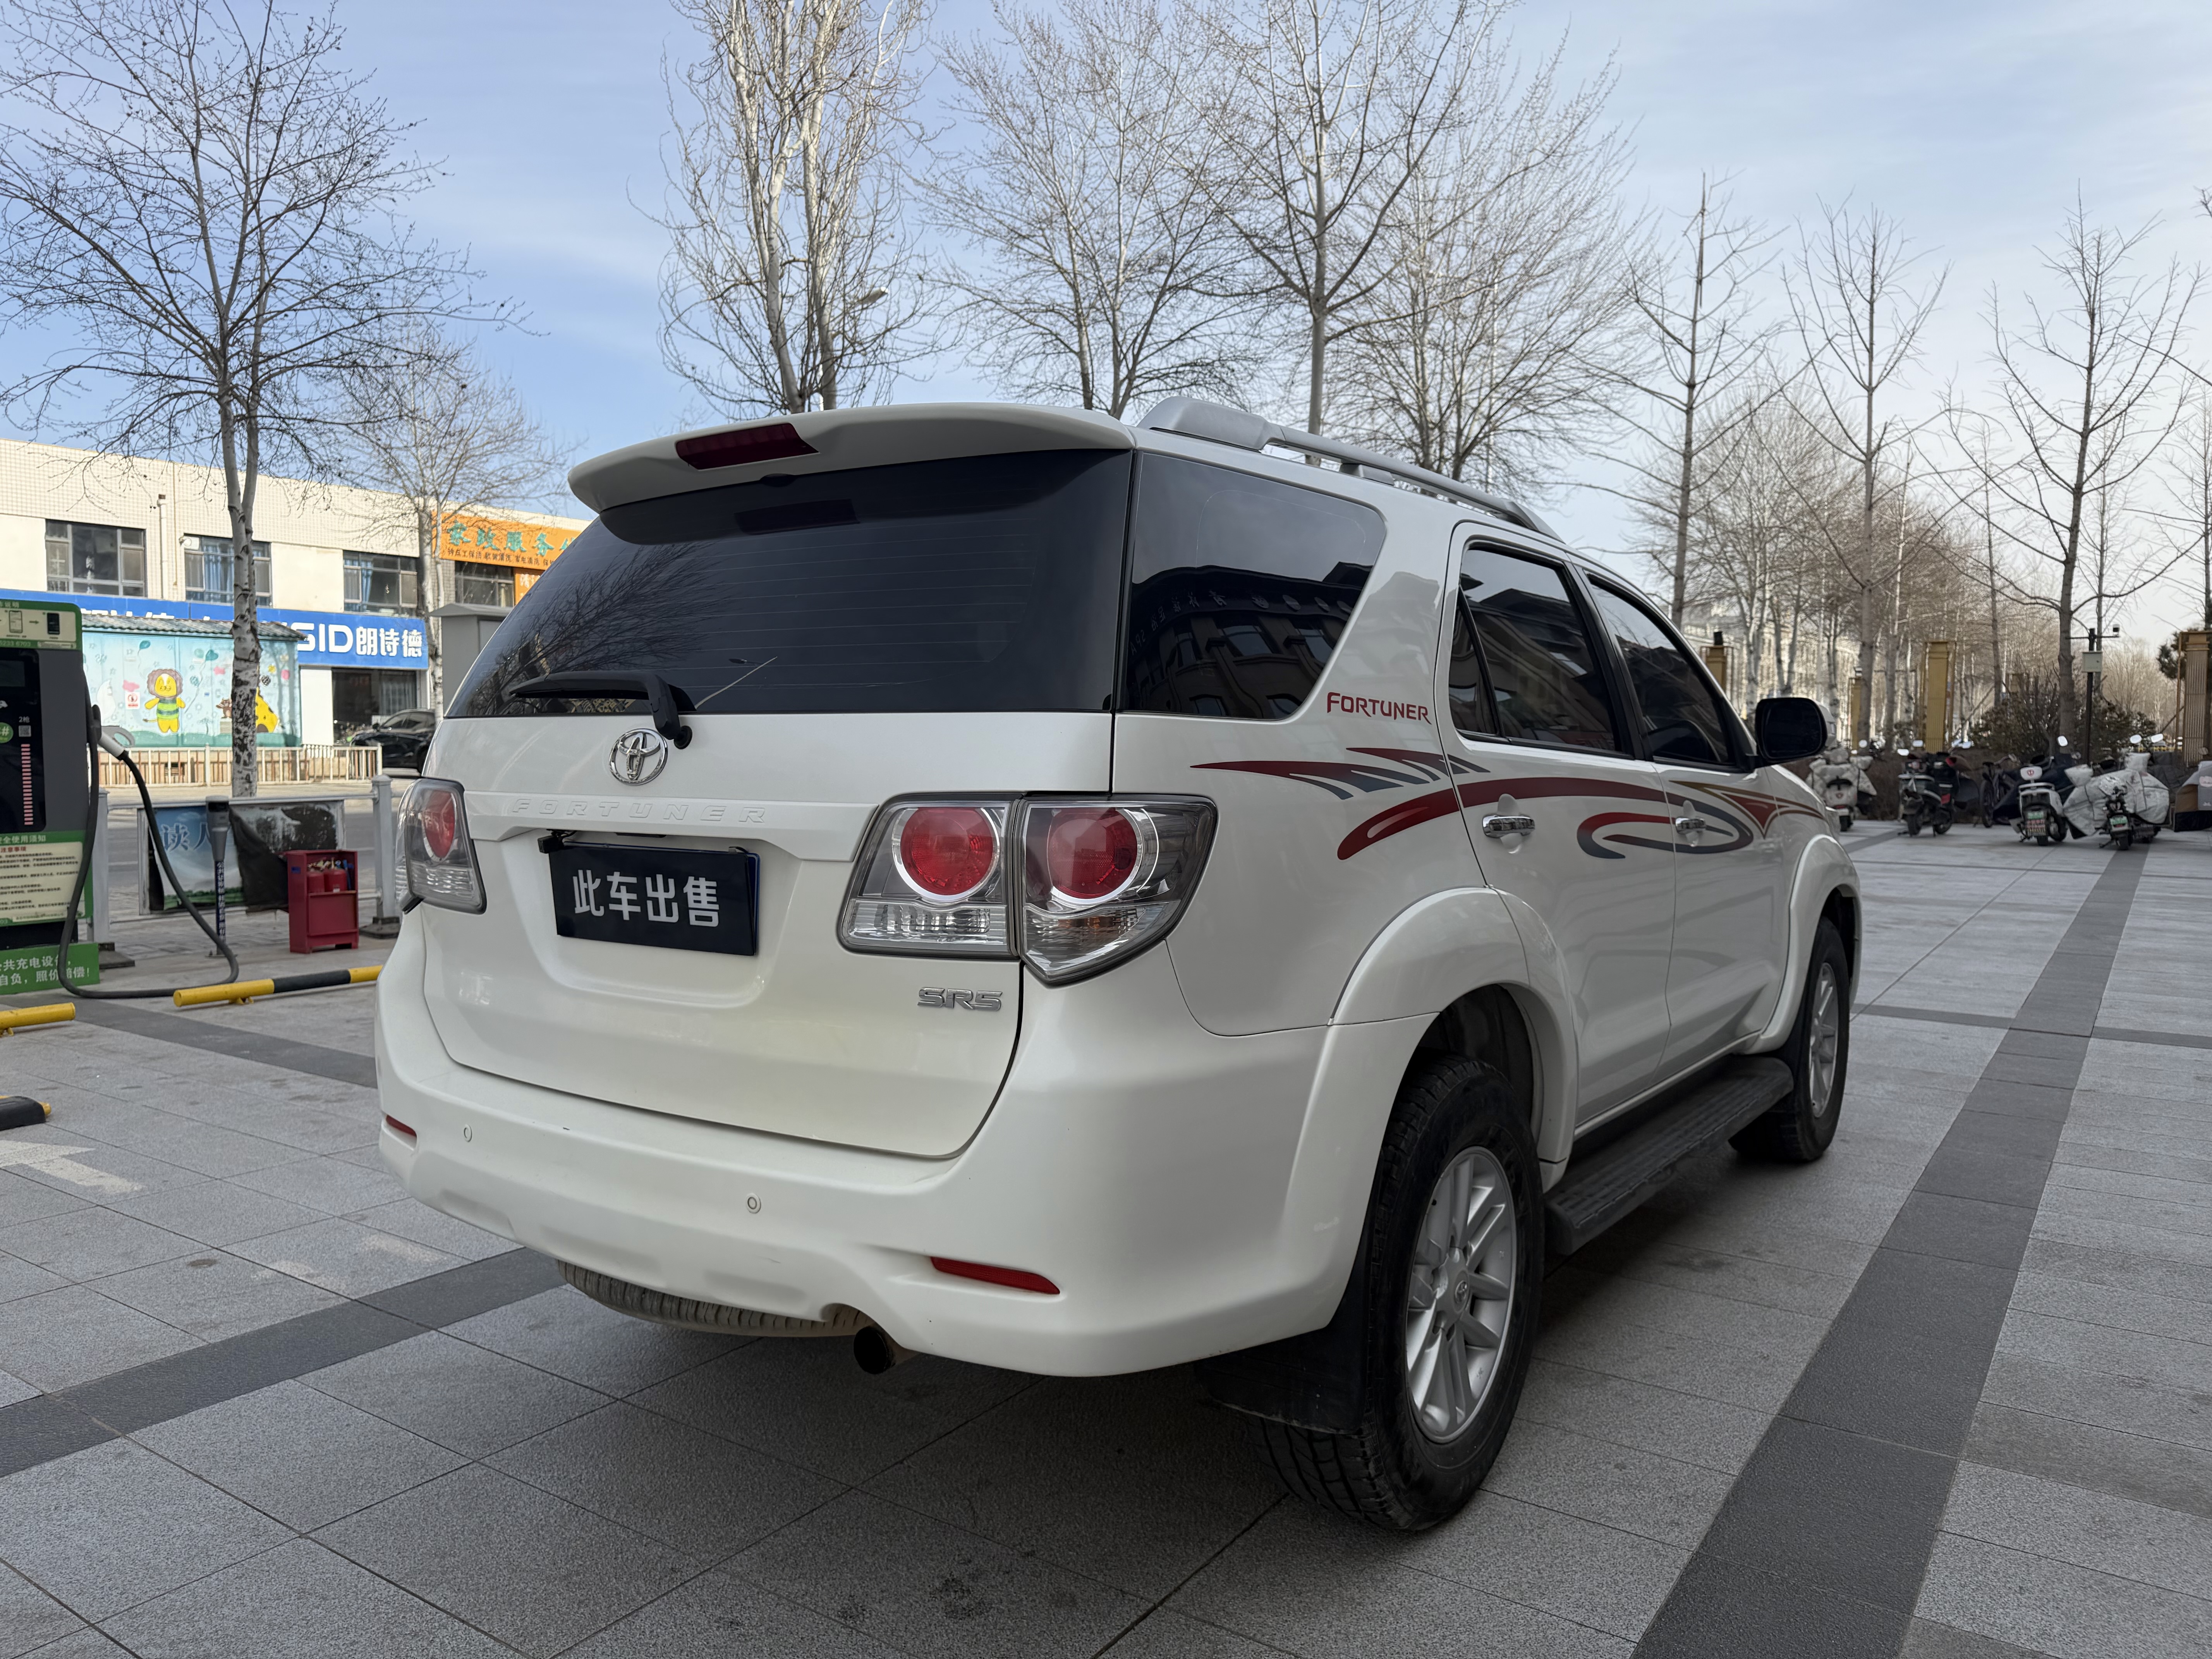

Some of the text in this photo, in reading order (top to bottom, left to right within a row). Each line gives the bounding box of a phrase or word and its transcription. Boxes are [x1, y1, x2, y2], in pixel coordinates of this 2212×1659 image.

[282, 622, 353, 653] SID
[356, 626, 422, 657] 朗诗德
[1327, 692, 1432, 725] FORTUNER
[512, 799, 765, 823] FORTUNER
[572, 869, 720, 927] 此车出售
[0, 954, 71, 971] 共充电设，
[917, 987, 1003, 1011] SR5
